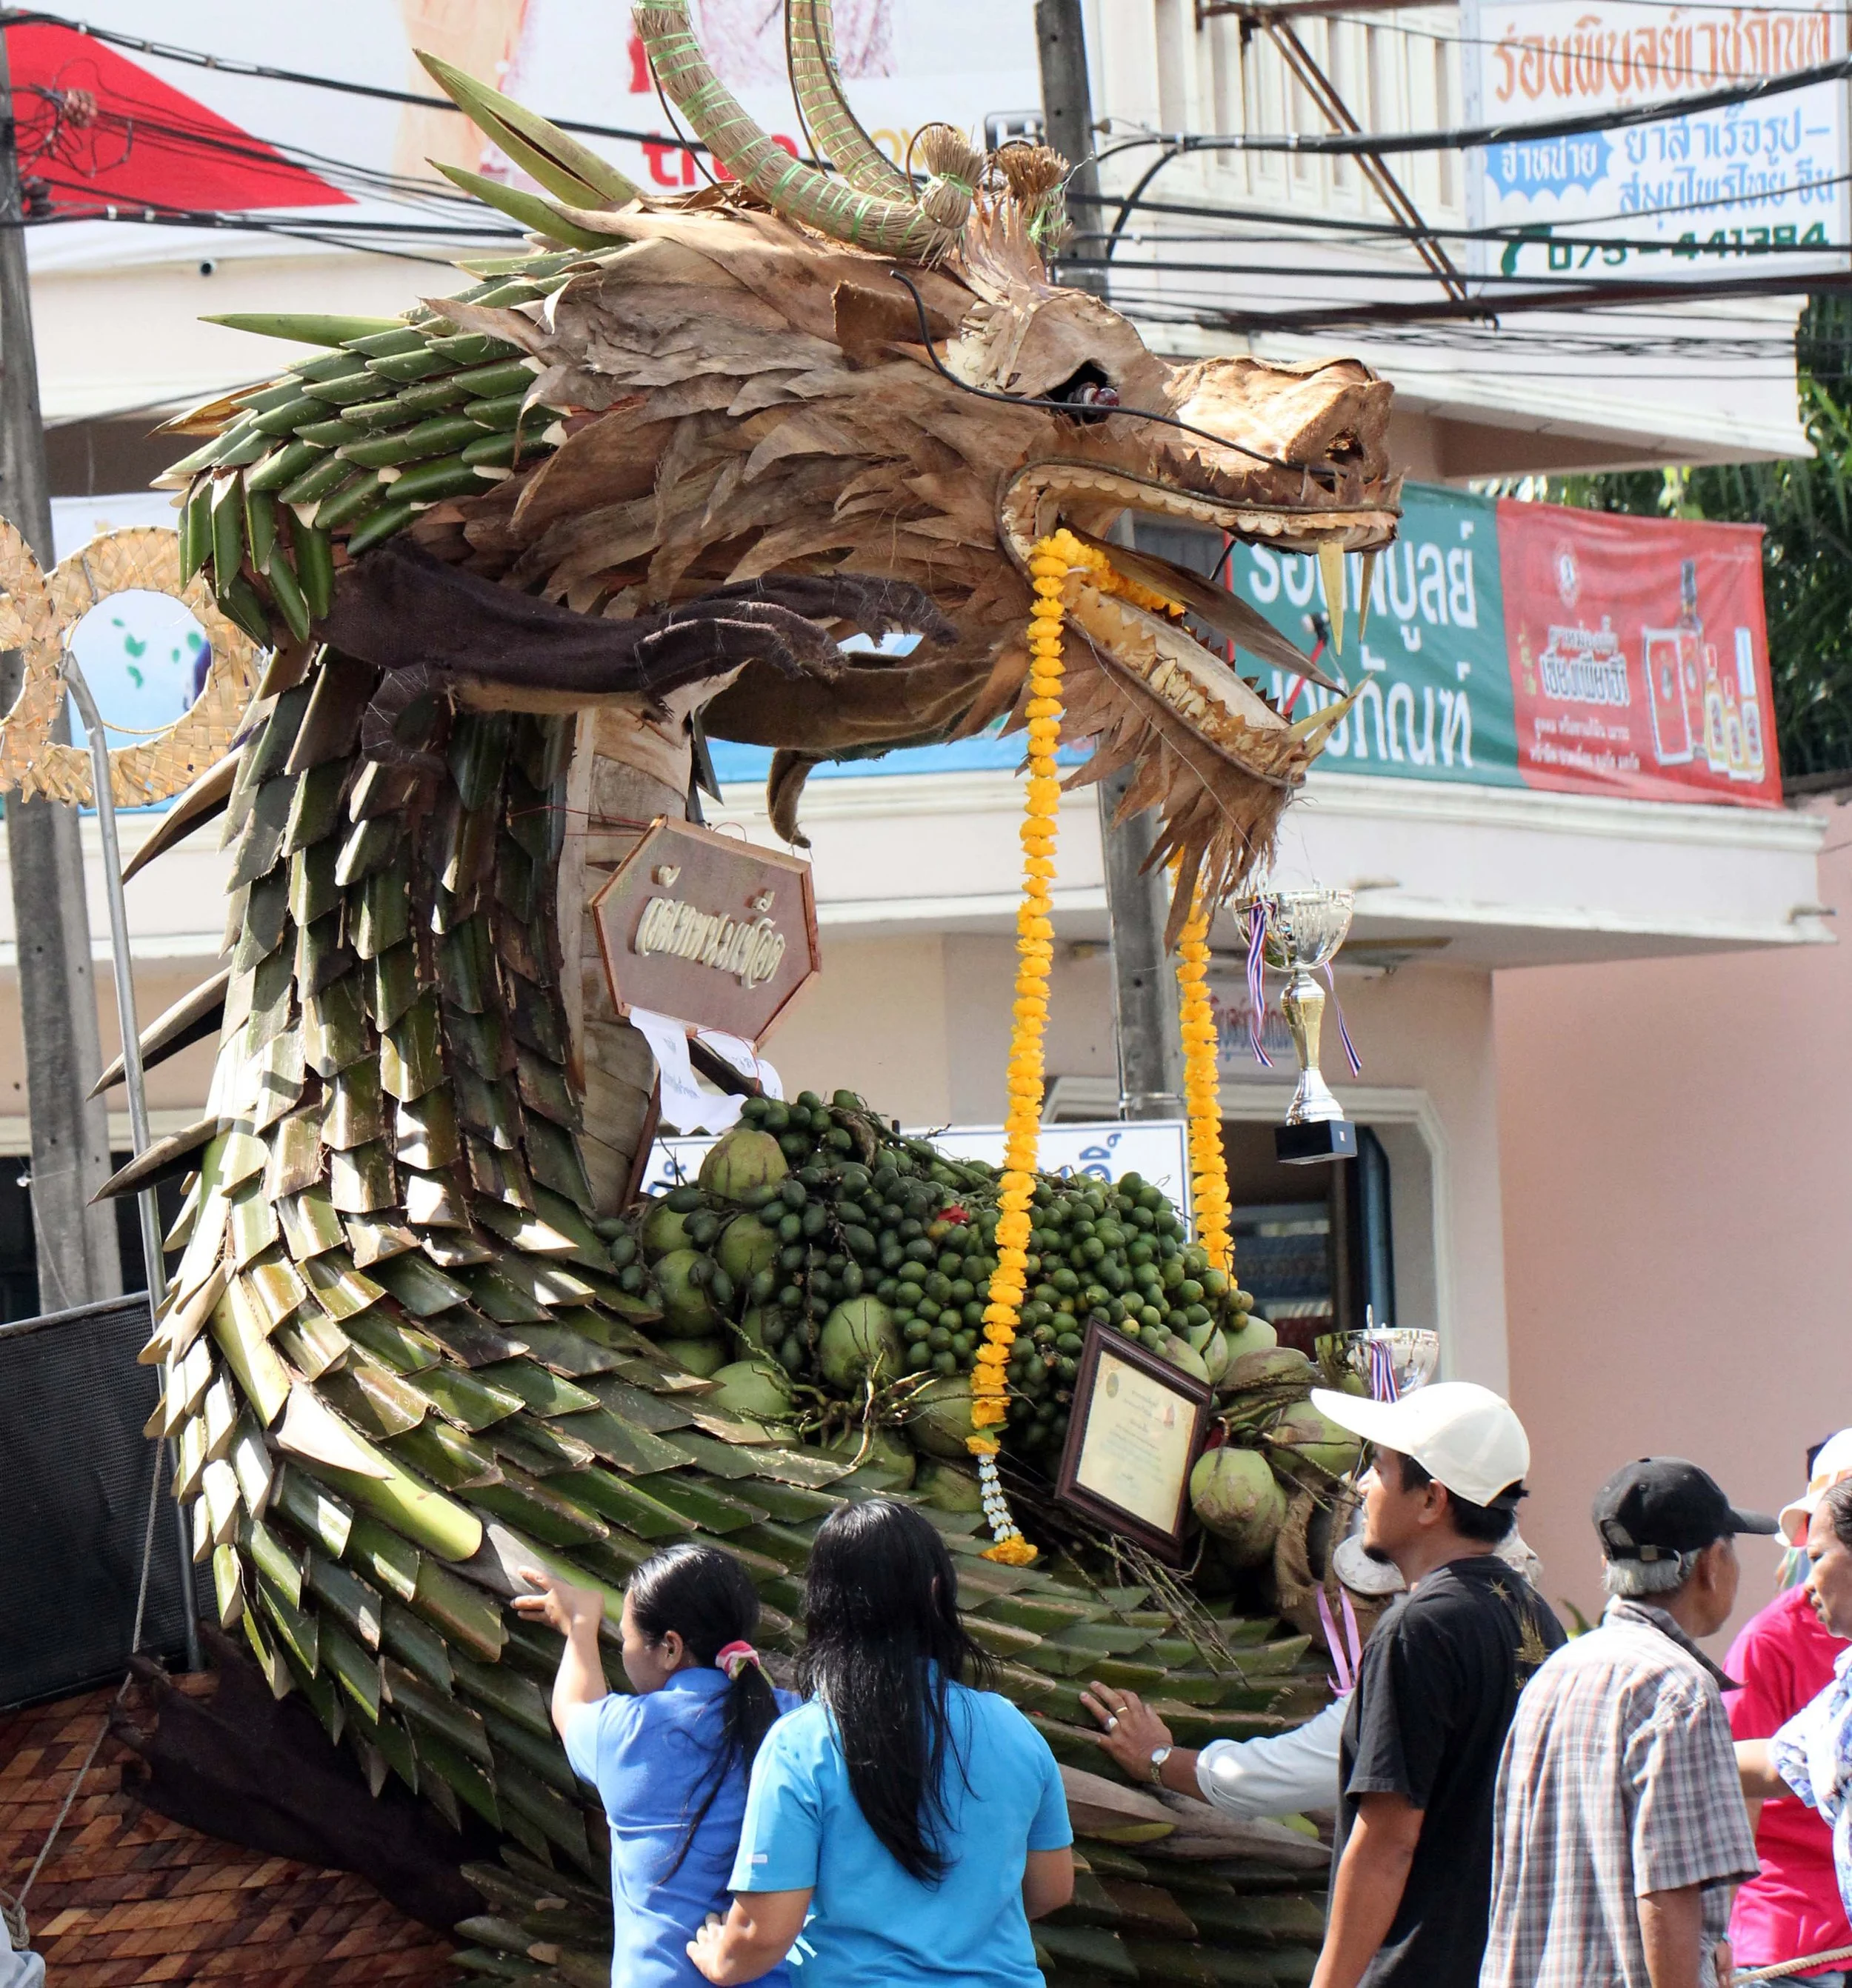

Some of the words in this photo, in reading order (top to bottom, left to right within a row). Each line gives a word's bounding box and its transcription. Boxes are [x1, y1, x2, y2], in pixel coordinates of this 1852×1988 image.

[1502, 135, 1598, 184] จำหน่าย
[1619, 161, 1786, 230] สมุนไพรไทย
